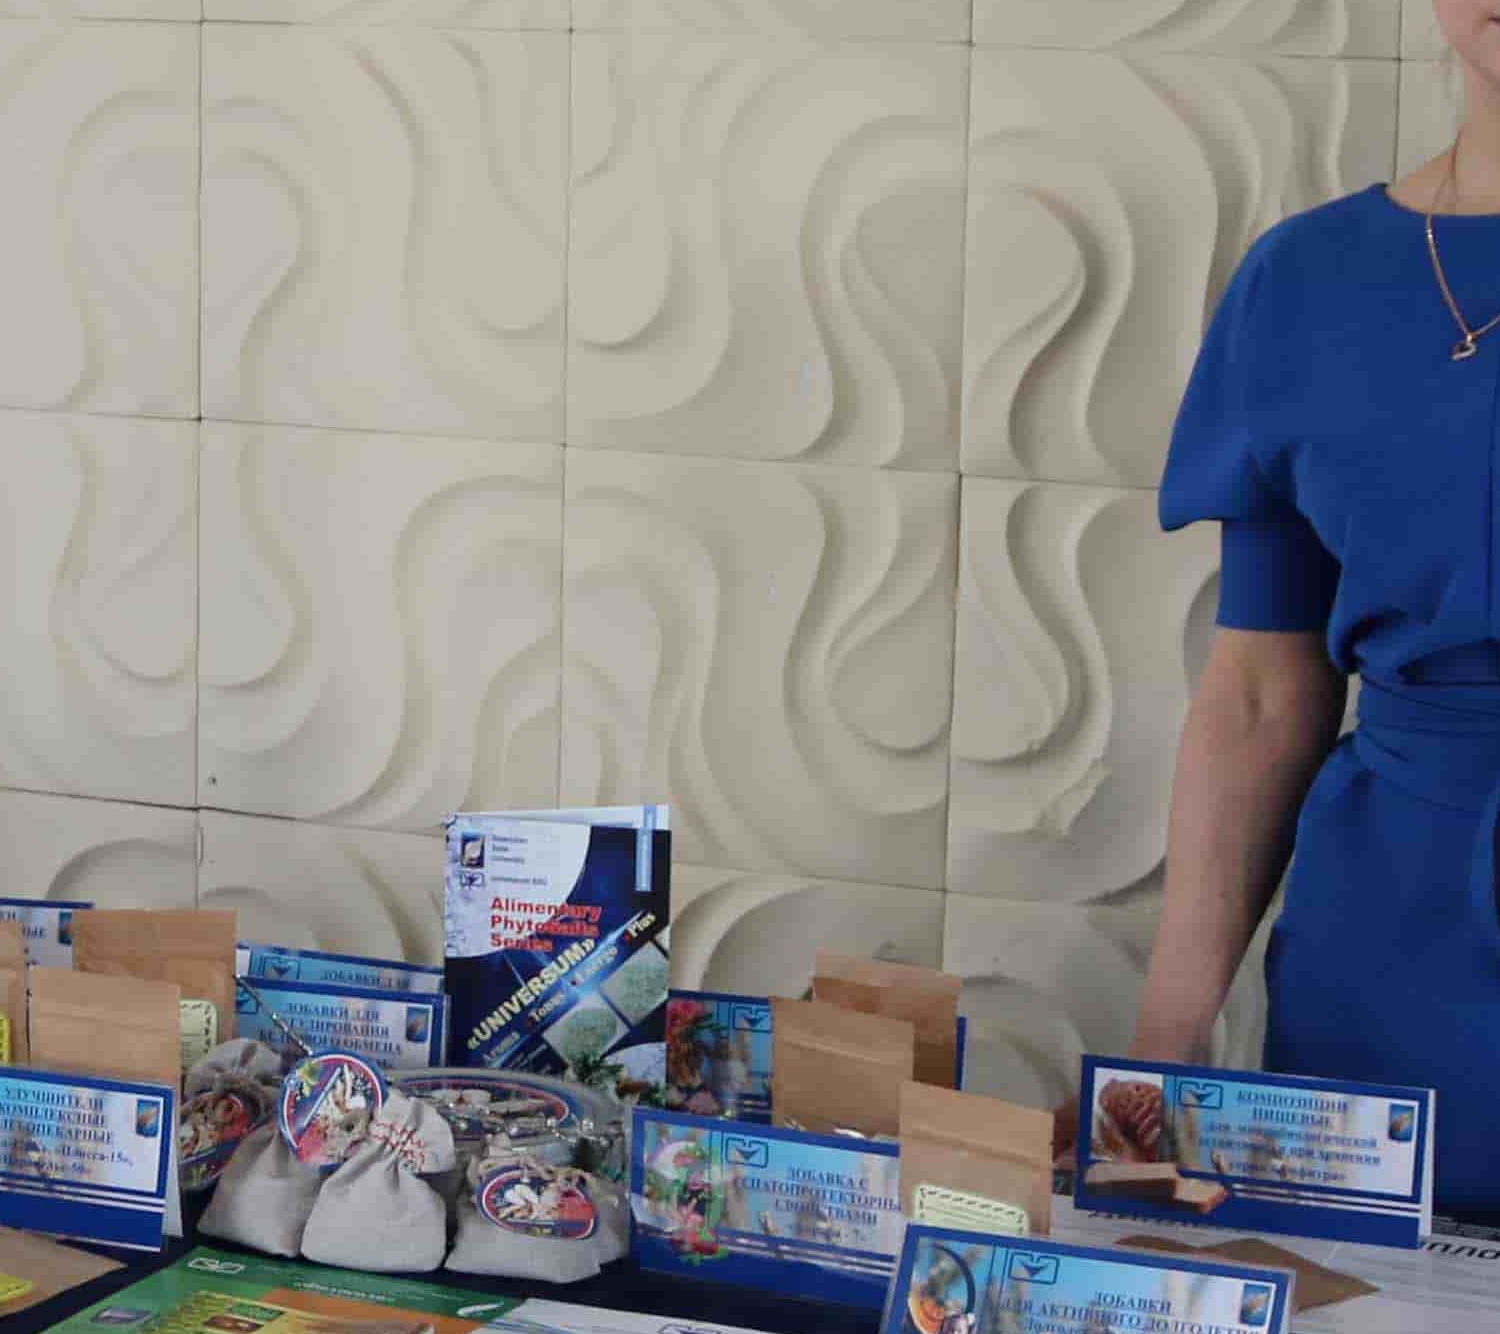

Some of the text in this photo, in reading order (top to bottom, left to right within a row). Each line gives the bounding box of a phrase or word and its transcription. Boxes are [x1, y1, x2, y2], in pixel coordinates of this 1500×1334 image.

[490, 897, 602, 923] Alimentary
[490, 933, 553, 953] Series
[467, 938, 596, 1051] «UNIVERSUM»
[1093, 1291, 1174, 1316] ДОБАВКИ
